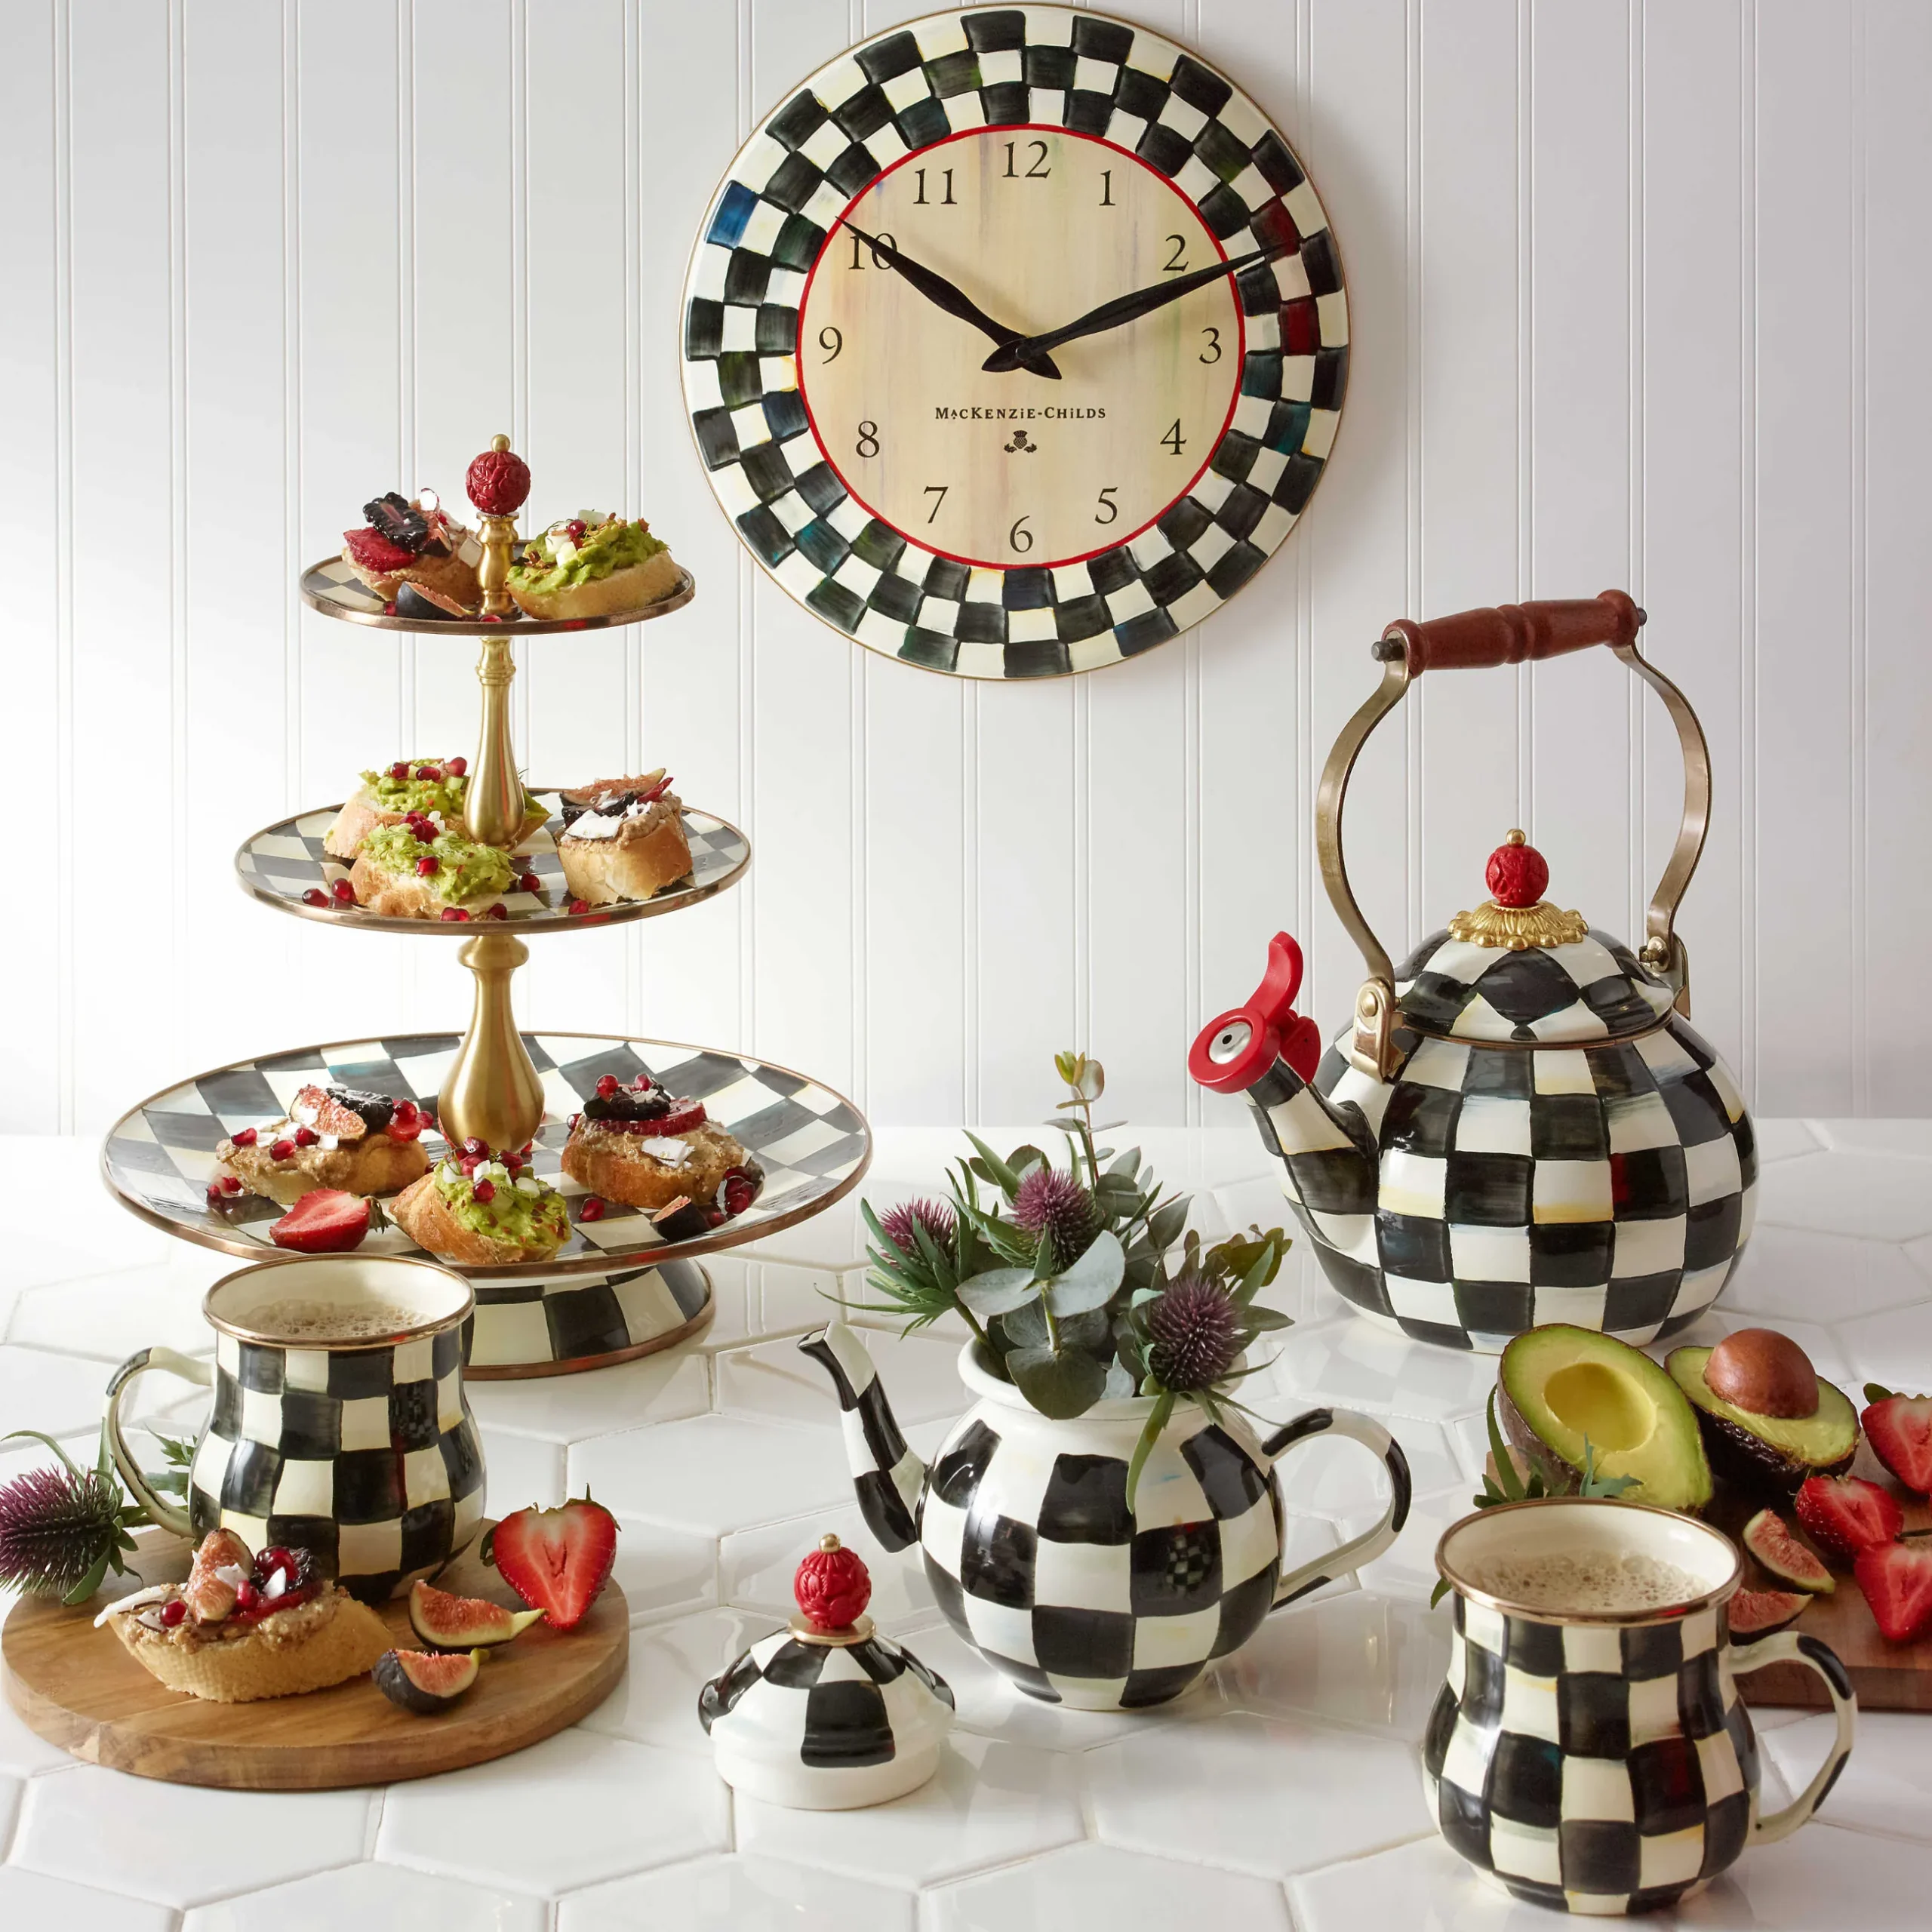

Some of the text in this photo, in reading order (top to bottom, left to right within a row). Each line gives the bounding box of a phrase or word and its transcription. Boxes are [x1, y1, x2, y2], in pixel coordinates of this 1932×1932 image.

[1001, 140, 1051, 179] 12
[912, 168, 958, 205] 11
[1098, 170, 1116, 206] 1
[848, 233, 898, 270] 10
[1162, 234, 1189, 272] 2
[819, 326, 843, 365] 9
[1198, 327, 1222, 365] 3
[856, 420, 880, 458] 8
[1159, 417, 1187, 456] 4
[923, 485, 949, 524] 7
[1094, 487, 1118, 525] 5
[1009, 515, 1033, 553] 6
